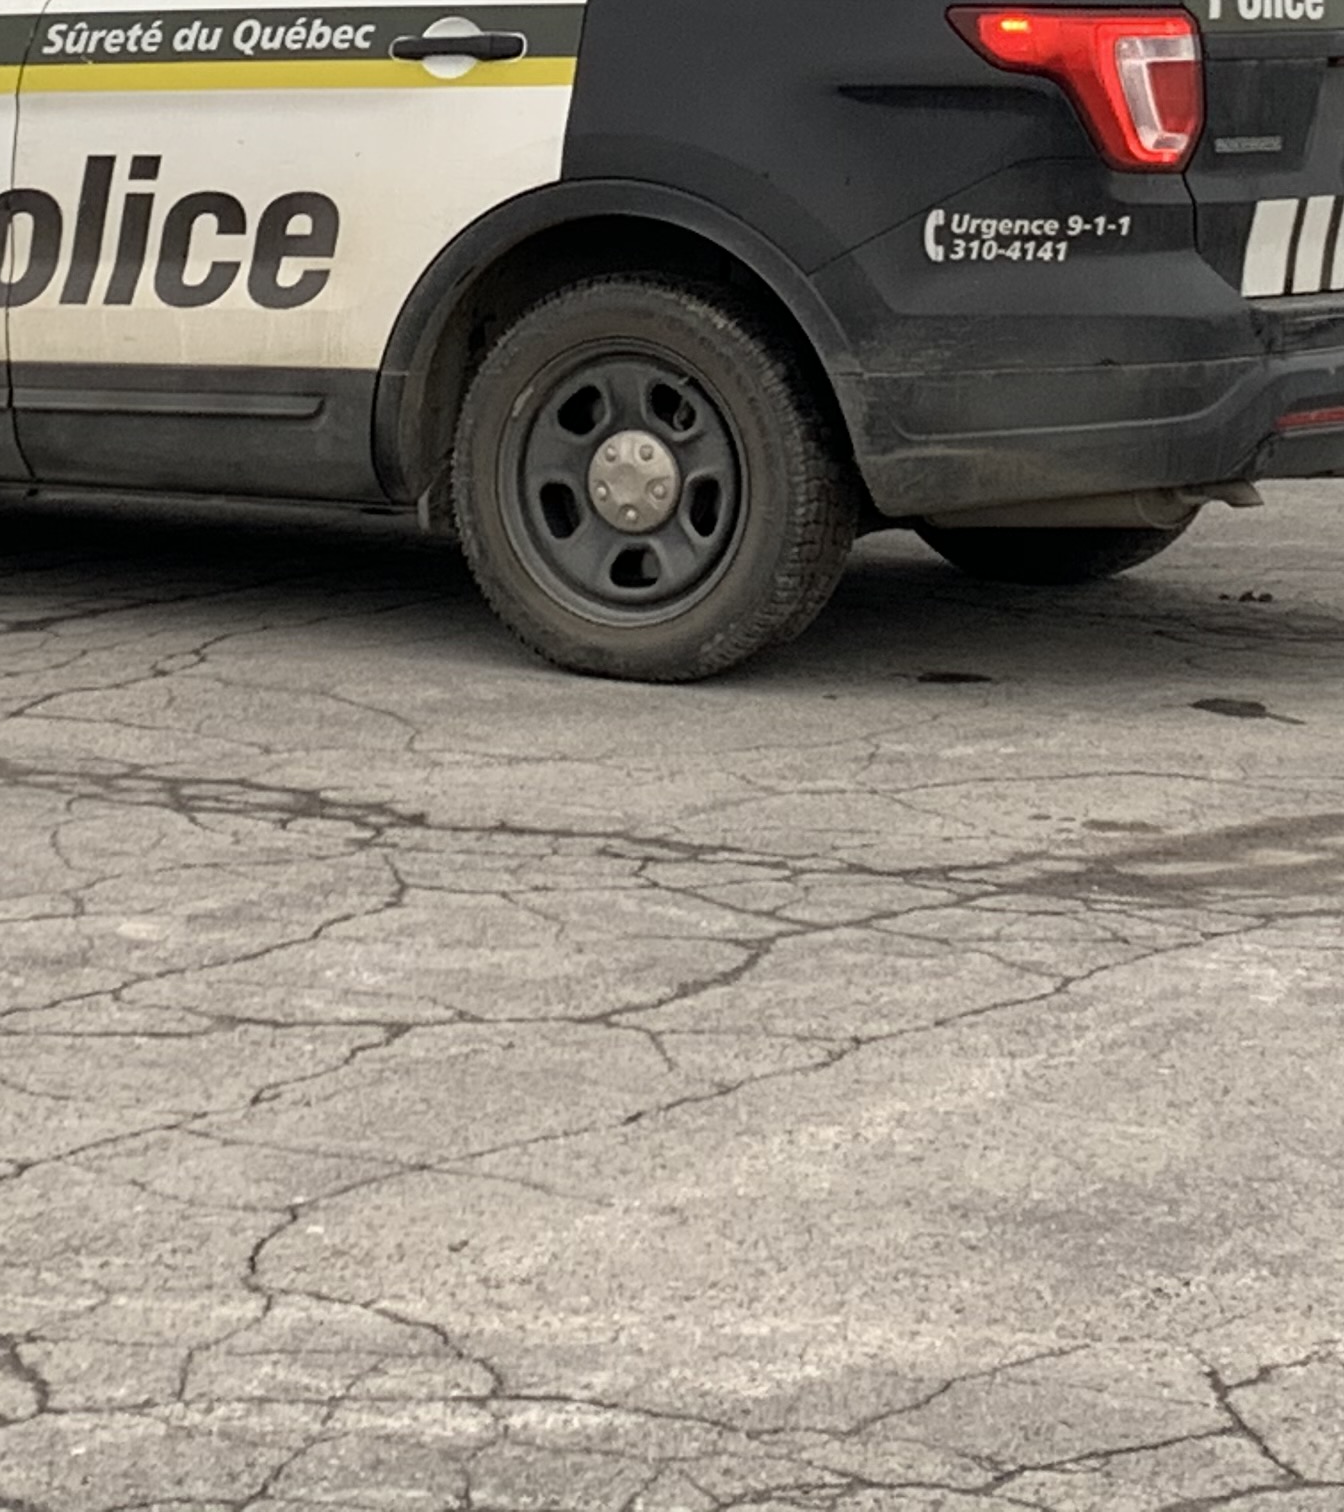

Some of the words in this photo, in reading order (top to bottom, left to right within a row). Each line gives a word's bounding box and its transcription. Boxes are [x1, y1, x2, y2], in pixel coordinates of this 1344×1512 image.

[42, 20, 164, 55] Sûreté
[172, 20, 224, 52] du
[232, 17, 377, 56] Québec
[950, 213, 1060, 239] Urgence
[1066, 214, 1132, 236] 9-1-1
[949, 238, 1069, 262] 310-4141
